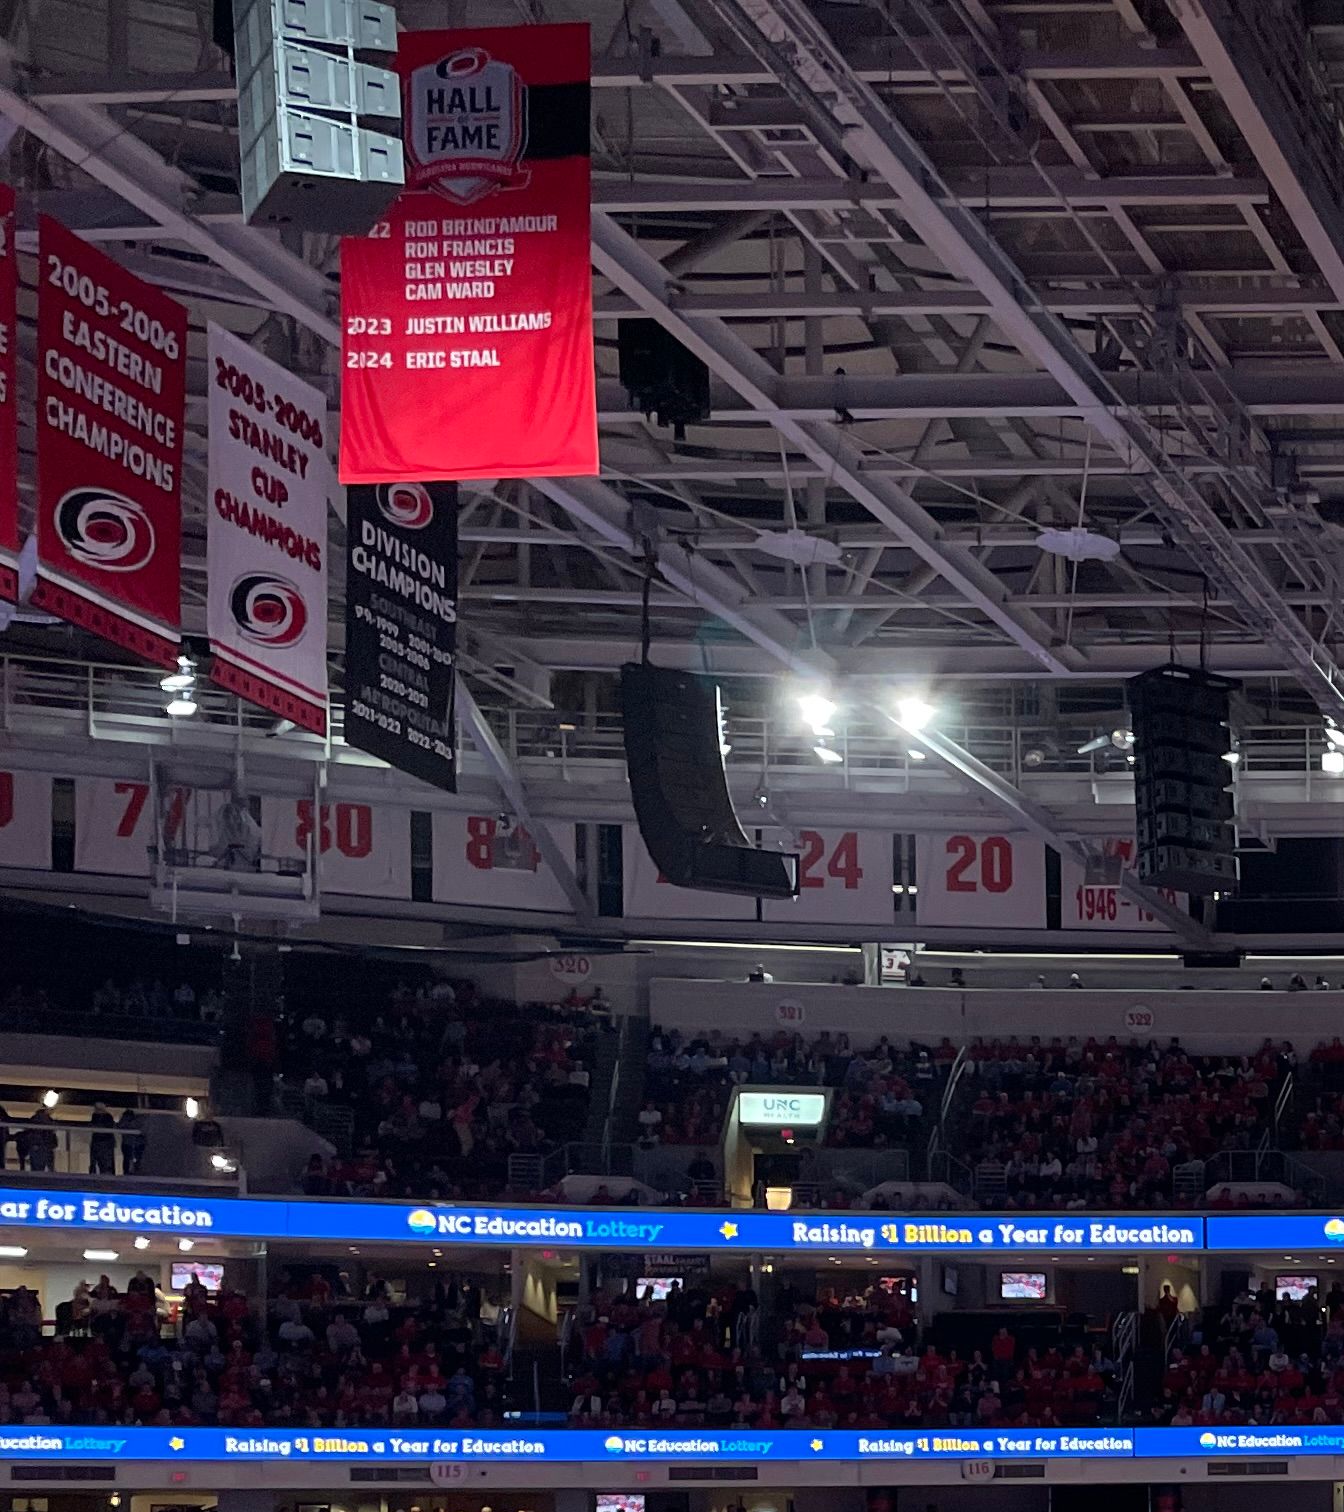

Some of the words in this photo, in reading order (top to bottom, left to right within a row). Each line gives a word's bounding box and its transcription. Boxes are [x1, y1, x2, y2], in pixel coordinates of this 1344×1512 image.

[427, 87, 499, 112] HALL
[427, 124, 500, 152] FAME
[405, 220, 437, 238] ROD
[442, 215, 558, 236] BRIND'AMOUR
[405, 241, 438, 258] RON
[443, 239, 514, 256] FRANCIS
[405, 262, 445, 279] GLEN
[449, 259, 514, 278] WESLEY
[405, 283, 442, 301] CAM
[446, 281, 495, 299] WARD
[47, 254, 180, 360] 2005-2006
[347, 318, 392, 335] 2023
[405, 316, 465, 335] JUSTIN
[469, 312, 552, 333] WILLIAMS
[62, 310, 162, 395] EASTERN
[347, 352, 393, 369] 2024
[405, 351, 446, 369] ERIC
[450, 349, 500, 367] STAAL
[45, 349, 175, 449] CONFERENCE
[215, 357, 324, 449] 2005-2006
[45, 396, 174, 492] CHAMPIONS
[229, 408, 309, 480] STANLEY
[251, 465, 290, 508] CUP
[214, 488, 322, 571] CHAMPIONS
[362, 519, 445, 588] DIVISION
[352, 546, 457, 623] CHAMPIONS
[945, 836, 1013, 894] 20
[763, 1099, 800, 1111] UNC
[36, 1199, 76, 1220] for
[83, 1201, 213, 1226] Education
[438, 1215, 471, 1234] NC
[474, 1216, 583, 1238] Education
[586, 1219, 662, 1241] Lottery
[793, 1222, 874, 1247] Raising
[882, 1226, 897, 1243] $1
[904, 1224, 972, 1243] Billion
[979, 1229, 992, 1243] a
[999, 1225, 1048, 1243] Year
[1054, 1224, 1084, 1243] for
[1090, 1224, 1193, 1243] Education
[65, 1437, 126, 1454] Lottery
[225, 1437, 290, 1456] Raising
[313, 1438, 368, 1453] Billion
[373, 1441, 384, 1453] a
[389, 1438, 429, 1453] Year
[433, 1438, 457, 1453] for
[462, 1438, 544, 1454] Education
[624, 1438, 646, 1453] NC
[648, 1438, 719, 1453] Education
[721, 1439, 773, 1455] Lottery
[858, 1438, 913, 1454] Raising
[933, 1438, 979, 1452] Billion
[983, 1441, 993, 1452] a
[997, 1437, 1033, 1452] Year
[1036, 1437, 1057, 1451] for
[1060, 1436, 1132, 1451] Education
[436, 1464, 462, 1478] 115
[968, 1462, 990, 1476] 116
